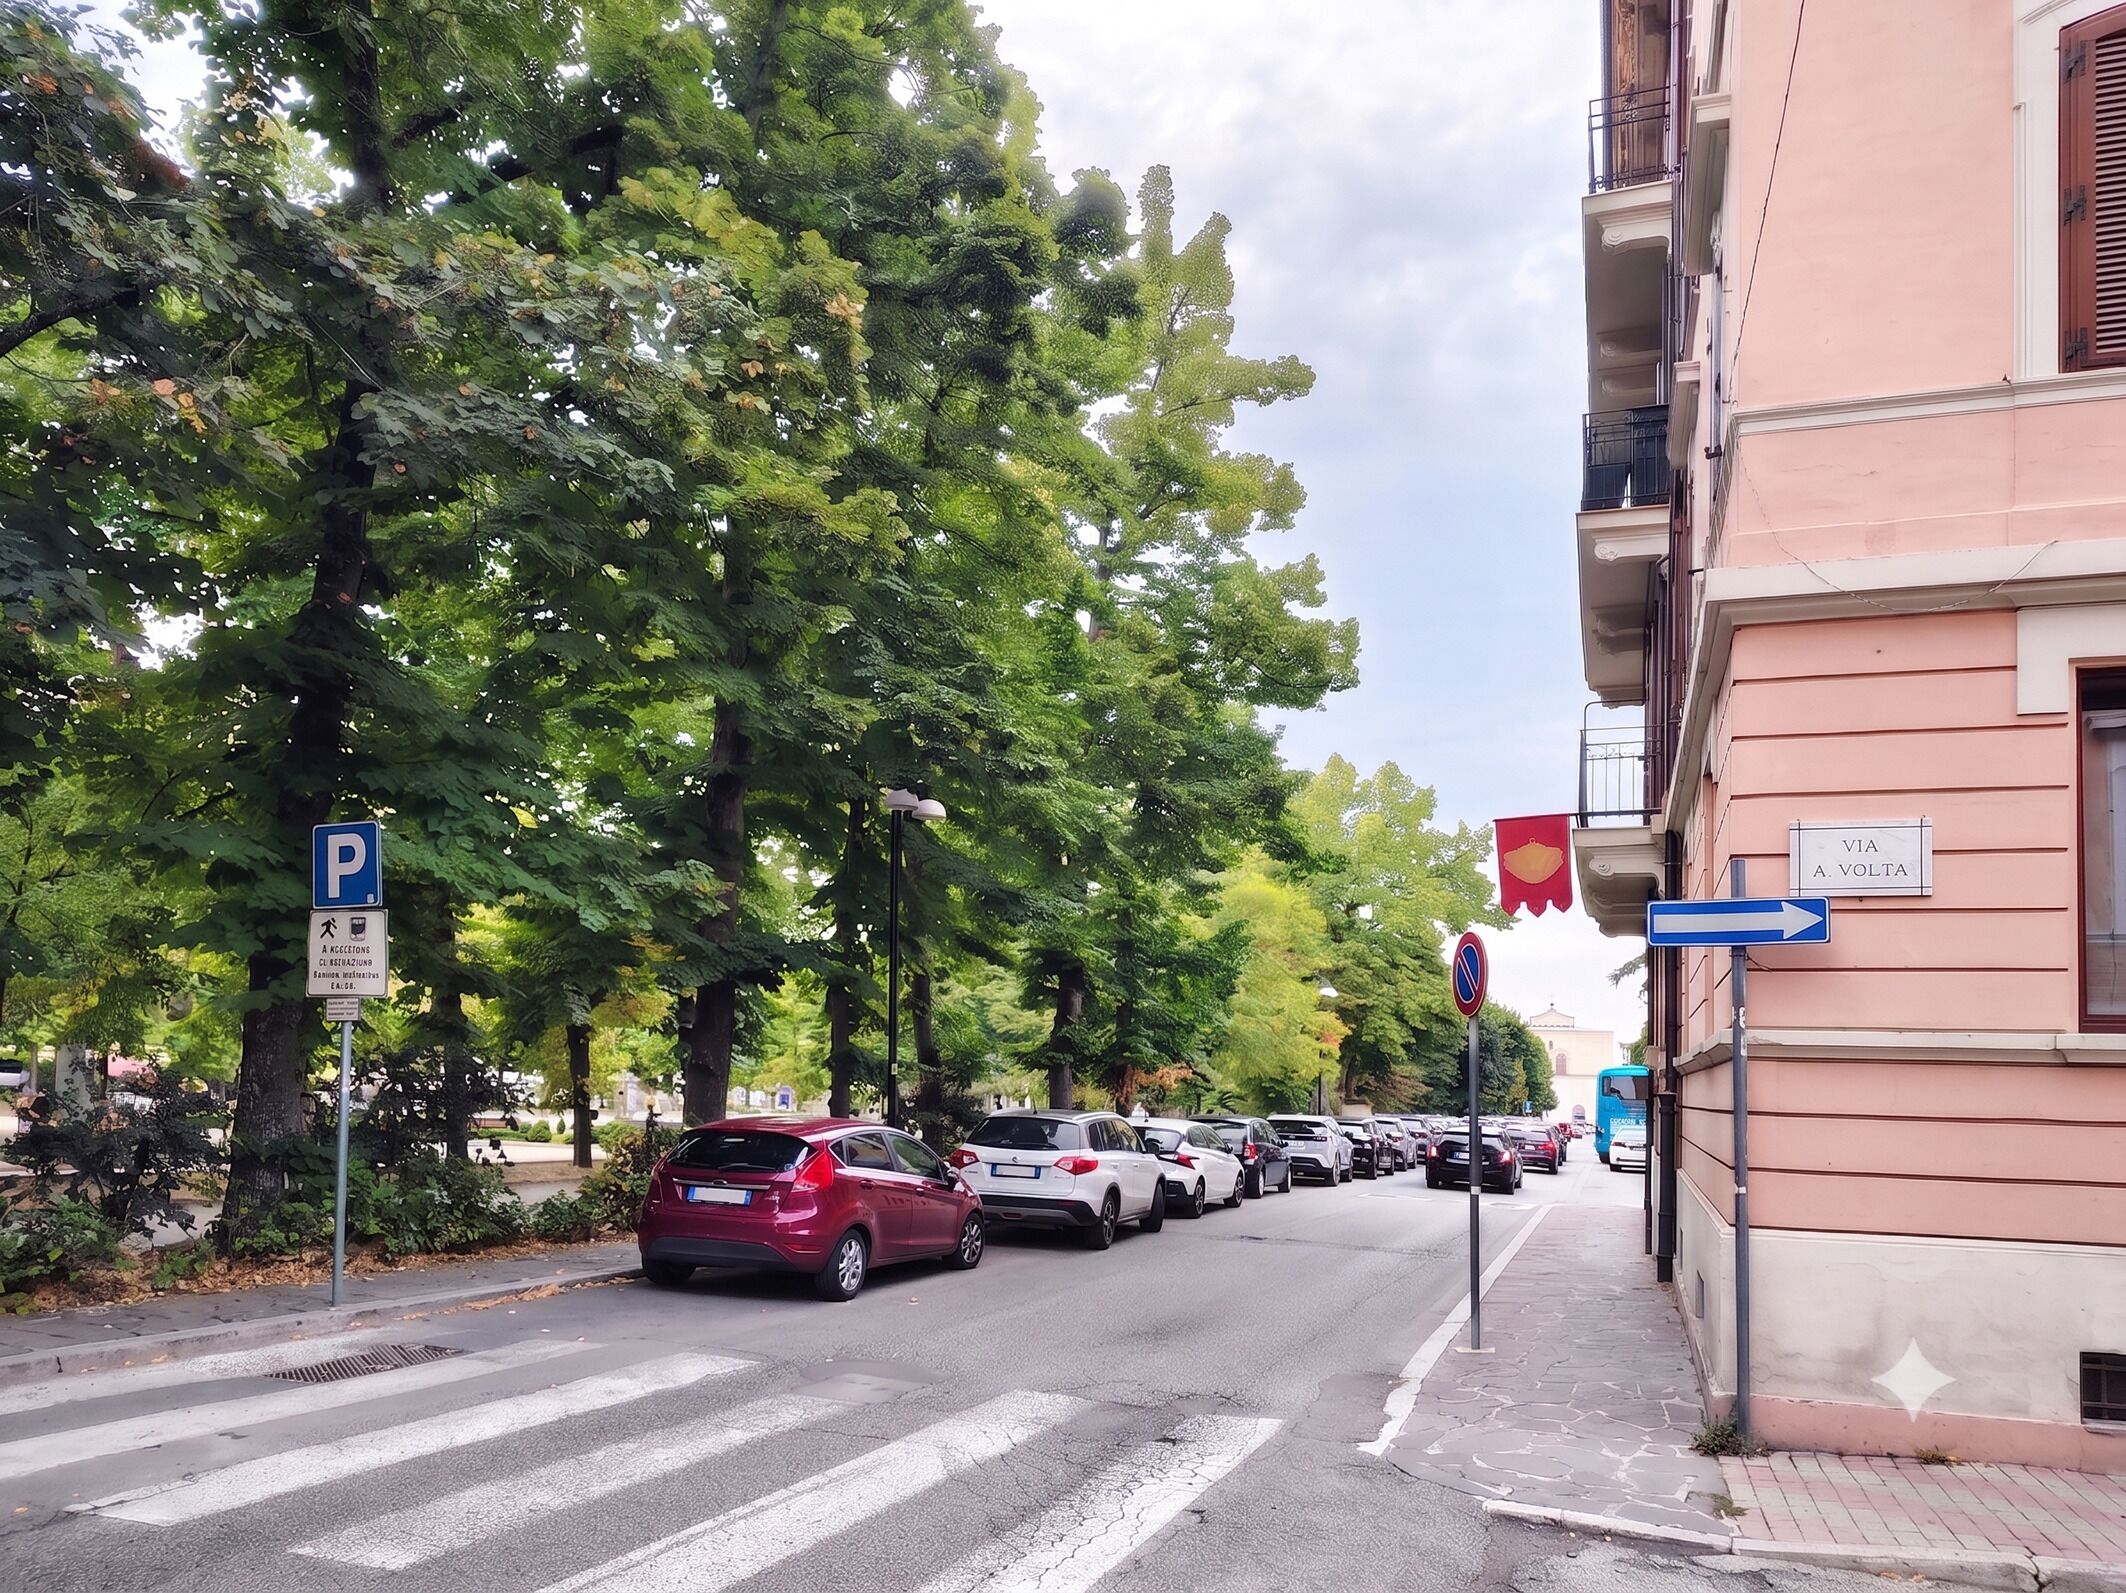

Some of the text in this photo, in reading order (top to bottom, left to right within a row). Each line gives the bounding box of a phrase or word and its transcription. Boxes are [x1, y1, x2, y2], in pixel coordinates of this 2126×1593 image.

[1841, 839, 1879, 853] VIA
[328, 833, 367, 899] P
[1812, 863, 1908, 878] A. VOLTA
